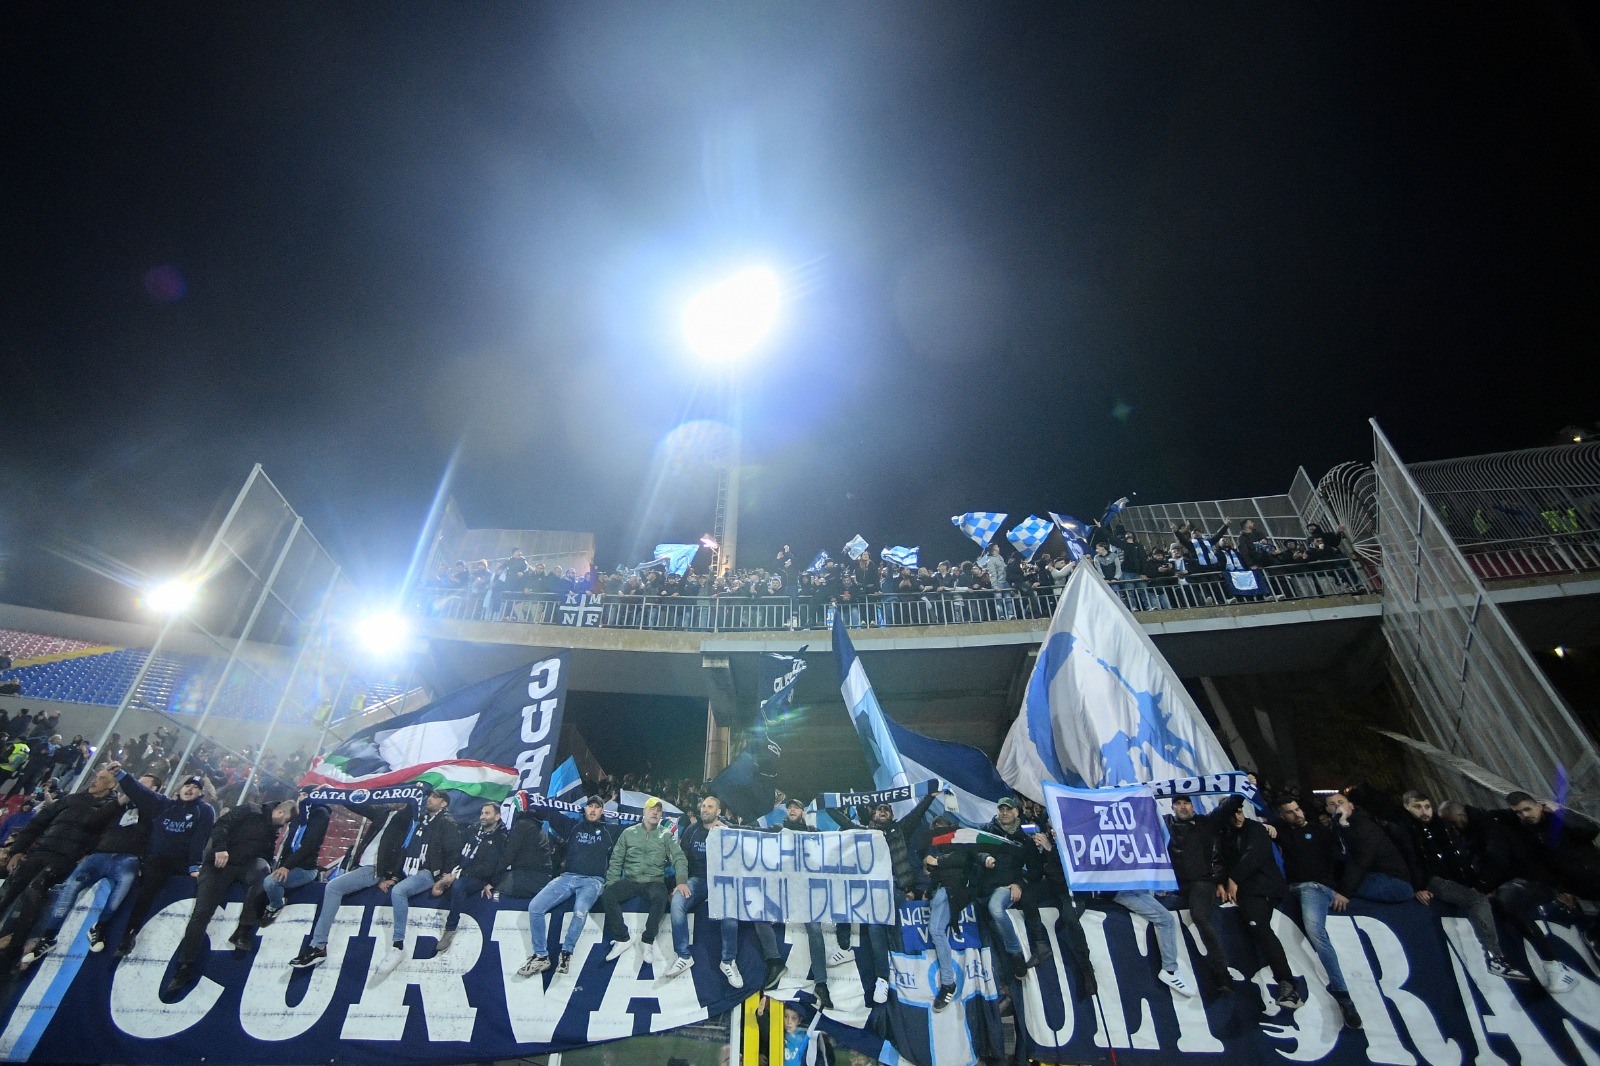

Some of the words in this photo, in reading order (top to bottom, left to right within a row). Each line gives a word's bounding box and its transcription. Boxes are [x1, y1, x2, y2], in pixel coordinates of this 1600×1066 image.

[309, 790, 346, 800] GATA
[842, 788, 909, 806] MASTIFFS
[1094, 802, 1136, 831] ZIO
[720, 828, 875, 874] POCHIELLO
[1068, 833, 1172, 866] PADELL
[713, 875, 790, 923] TIENI
[808, 877, 890, 925] DURO
[110, 898, 709, 1043] CURVA
